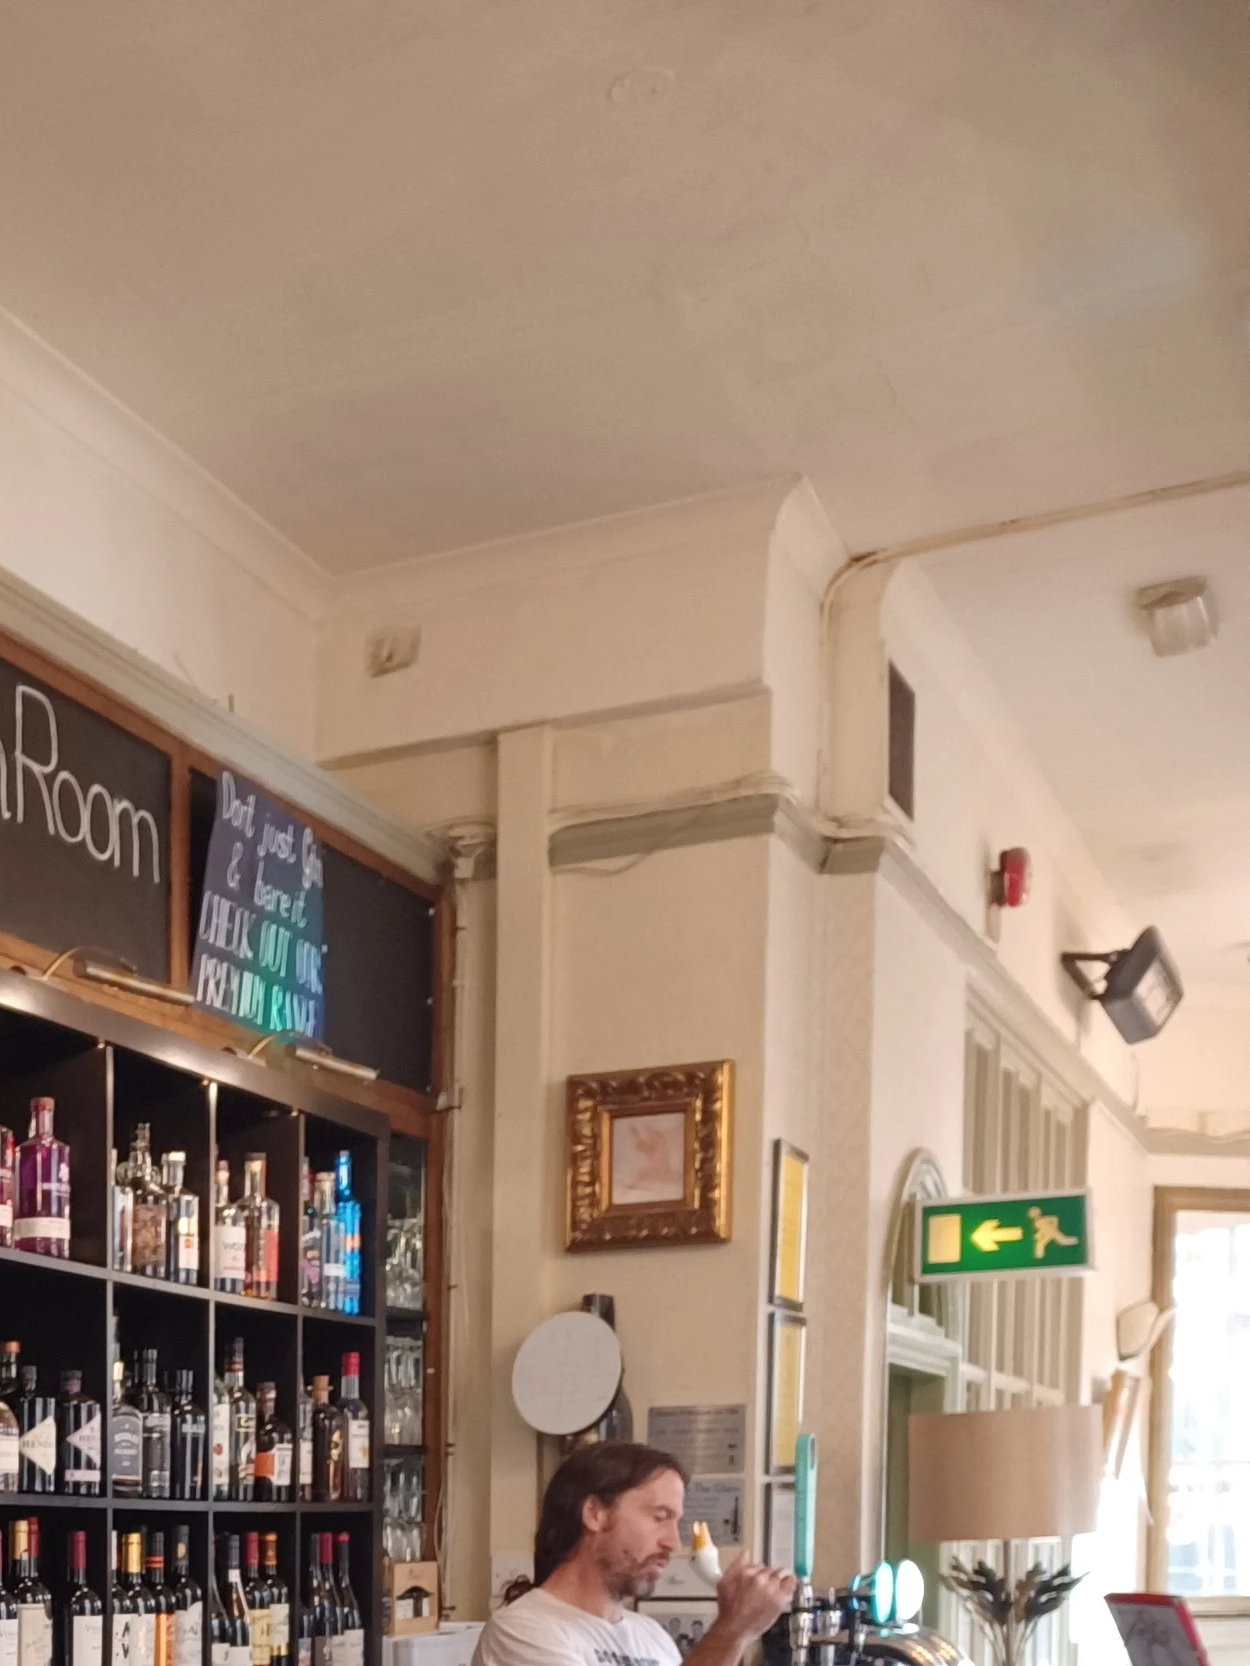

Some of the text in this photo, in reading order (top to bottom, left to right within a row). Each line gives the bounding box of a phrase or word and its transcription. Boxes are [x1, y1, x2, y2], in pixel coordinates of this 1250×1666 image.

[14, 683, 161, 884] Room
[257, 811, 297, 864] just
[199, 890, 257, 961] CHECK
[258, 919, 292, 978] OUT
